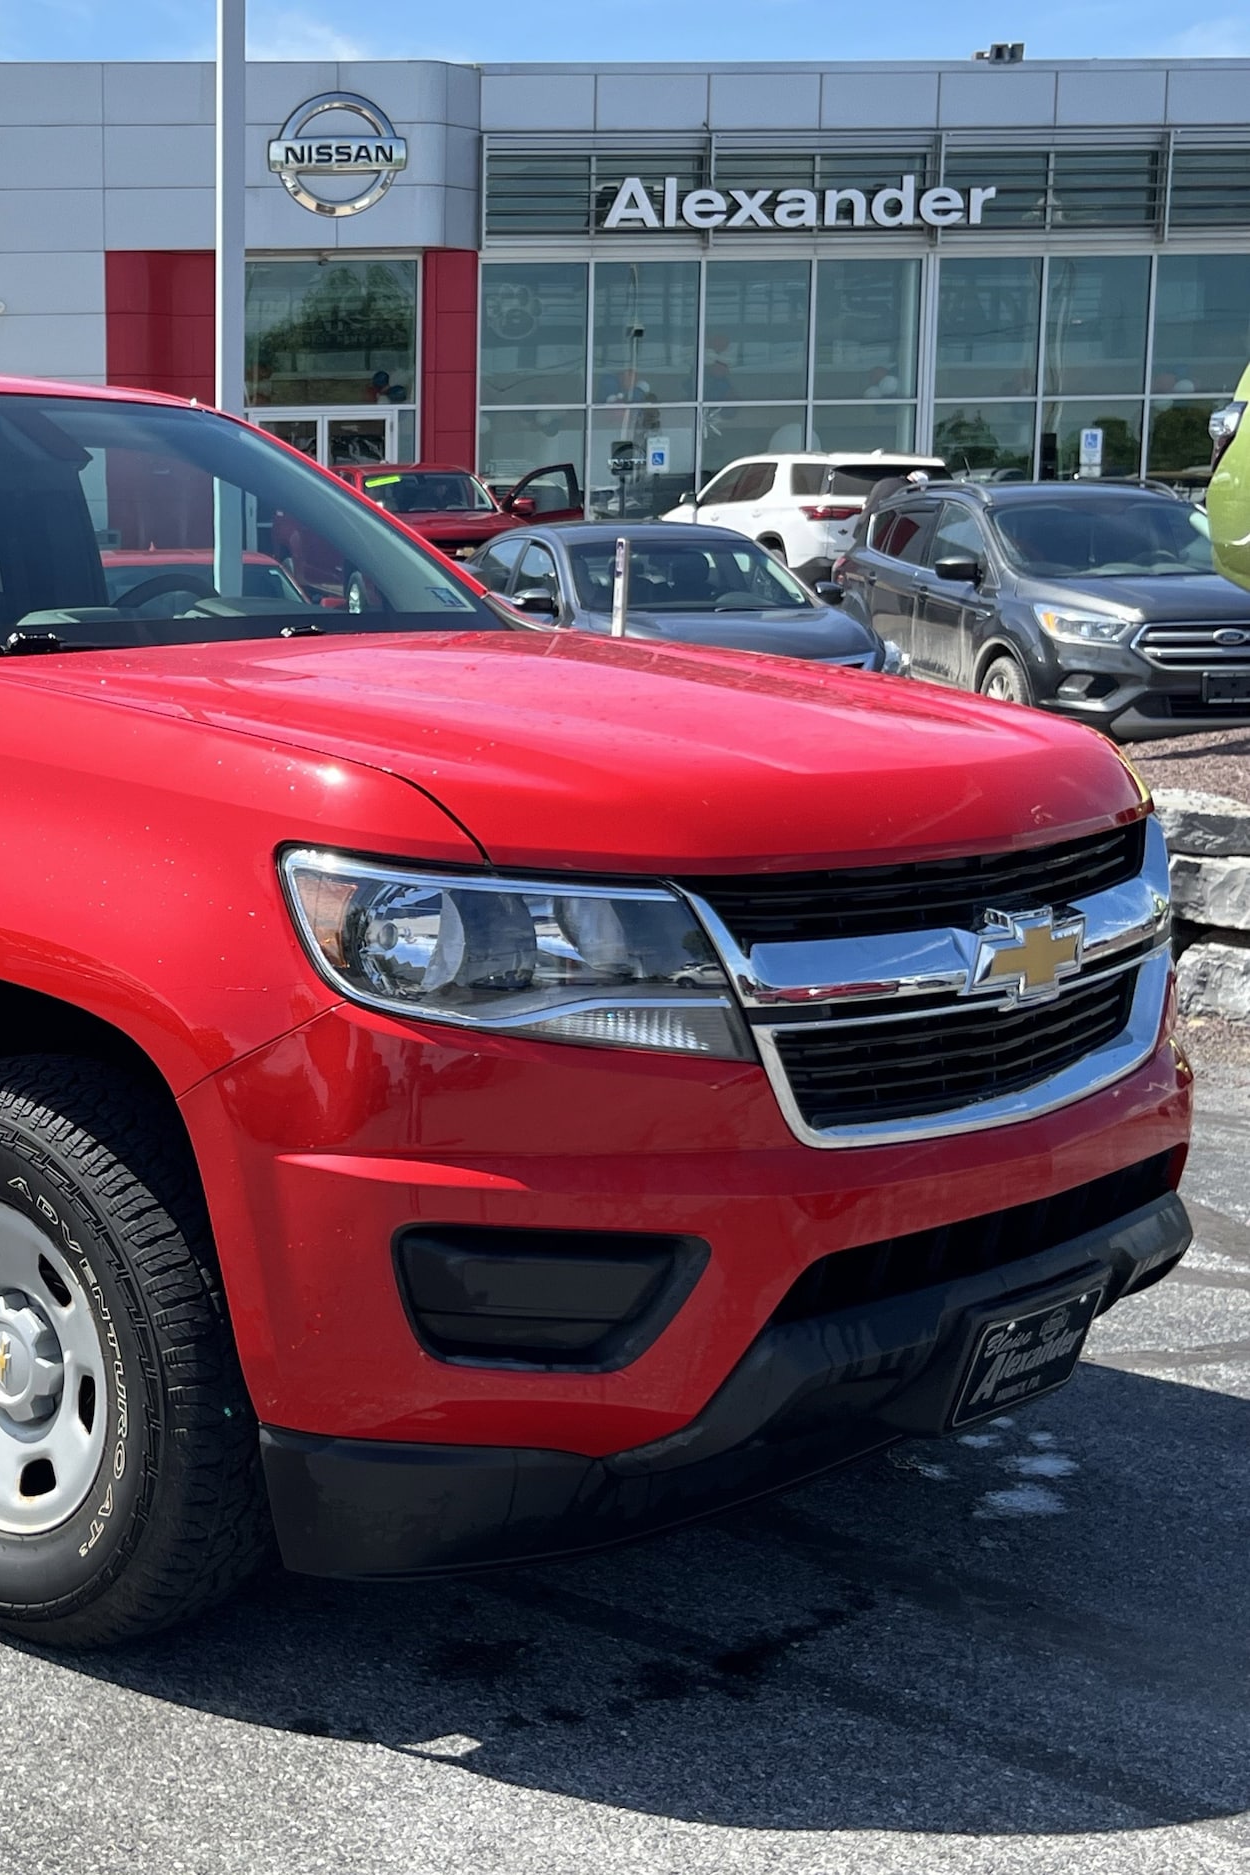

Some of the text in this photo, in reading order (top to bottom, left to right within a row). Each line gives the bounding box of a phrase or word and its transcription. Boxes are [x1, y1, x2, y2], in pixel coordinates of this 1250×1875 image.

[285, 144, 393, 165] NISSAN
[603, 174, 997, 229] Alexander
[6, 1176, 128, 1480] ADVENTURO
[968, 1327, 1084, 1406] Alexander
